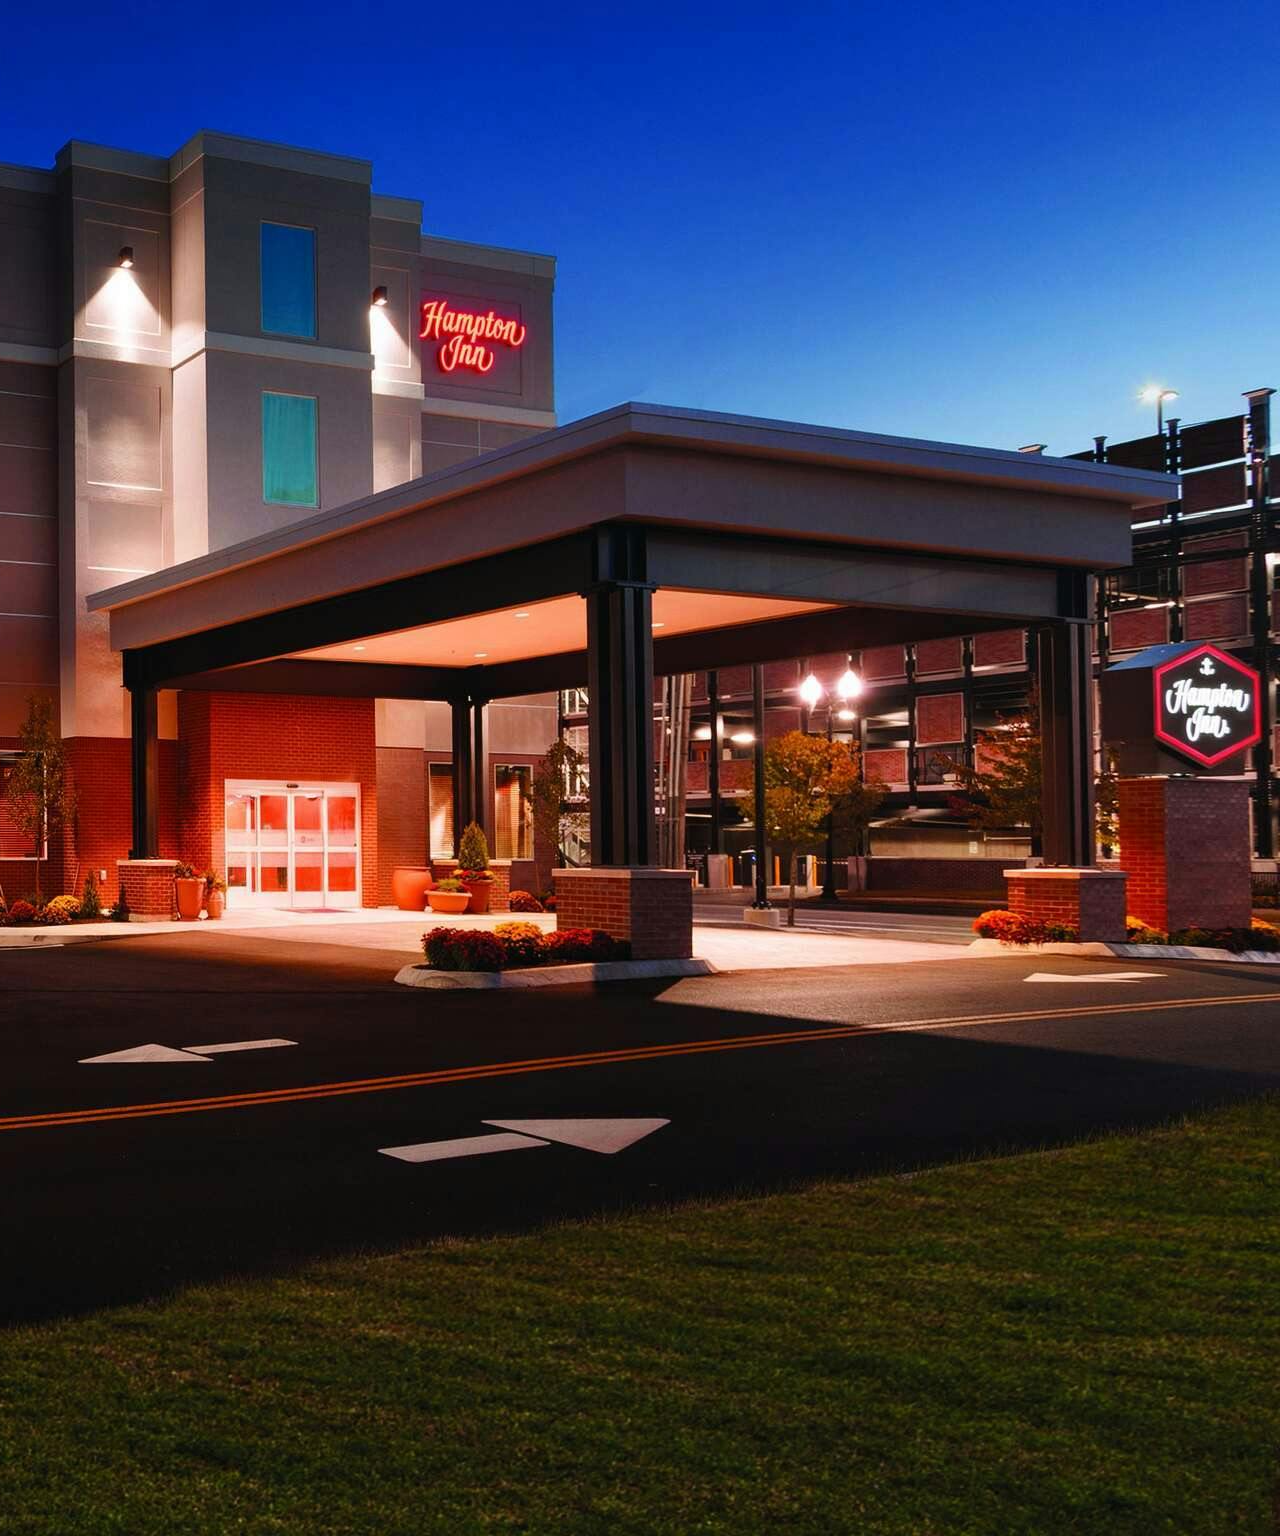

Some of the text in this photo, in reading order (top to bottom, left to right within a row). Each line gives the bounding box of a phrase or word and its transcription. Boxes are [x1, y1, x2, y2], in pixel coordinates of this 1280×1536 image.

[419, 300, 526, 346] Hampton
[441, 334, 494, 372] Inn
[1165, 678, 1251, 714] Hampton
